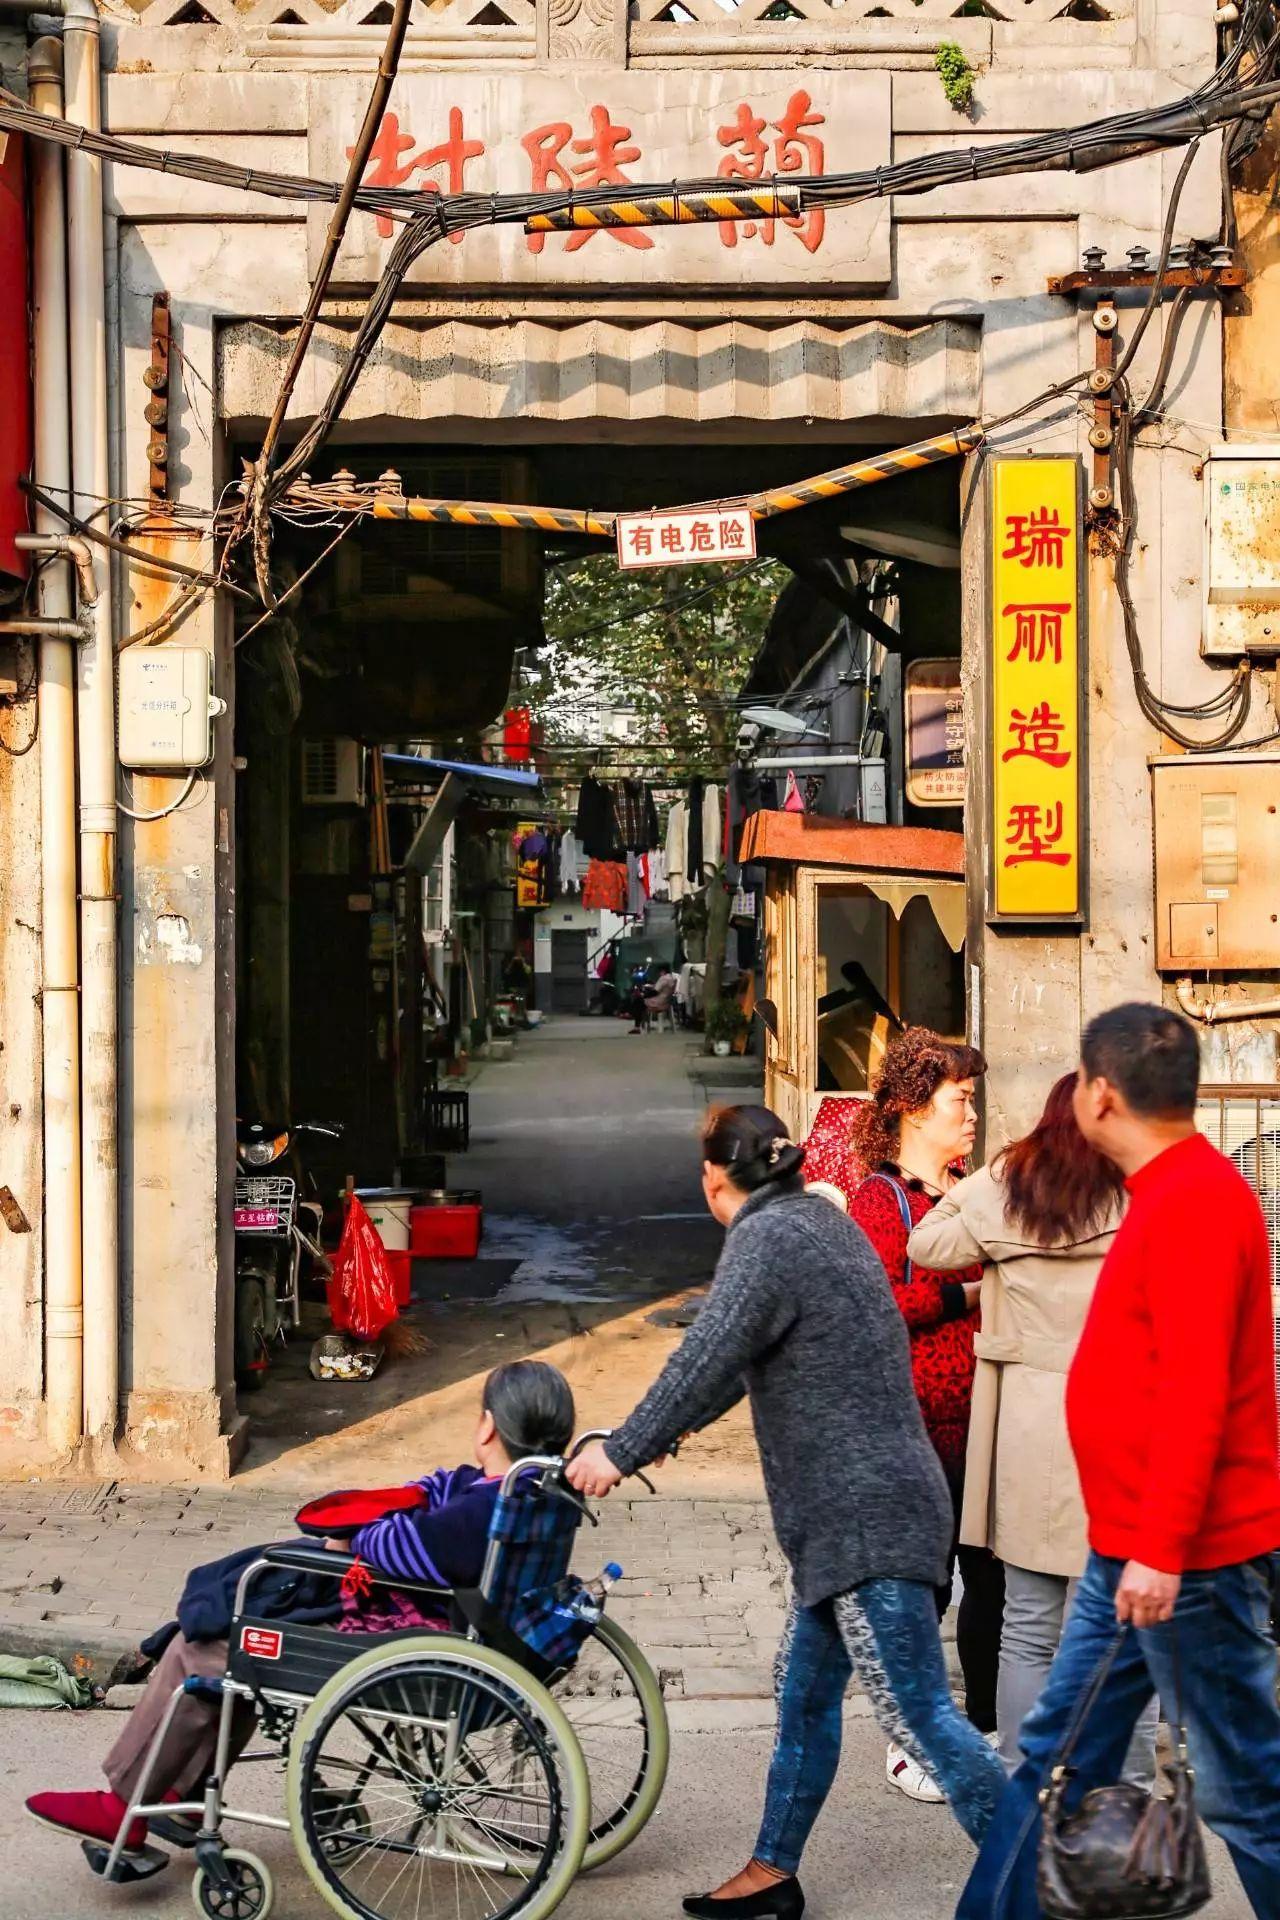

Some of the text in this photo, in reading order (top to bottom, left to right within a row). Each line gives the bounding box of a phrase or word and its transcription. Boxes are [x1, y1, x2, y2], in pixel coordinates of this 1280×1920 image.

[628, 519, 746, 556] 有电危险
[1002, 505, 1072, 868] 瑞丽造型
